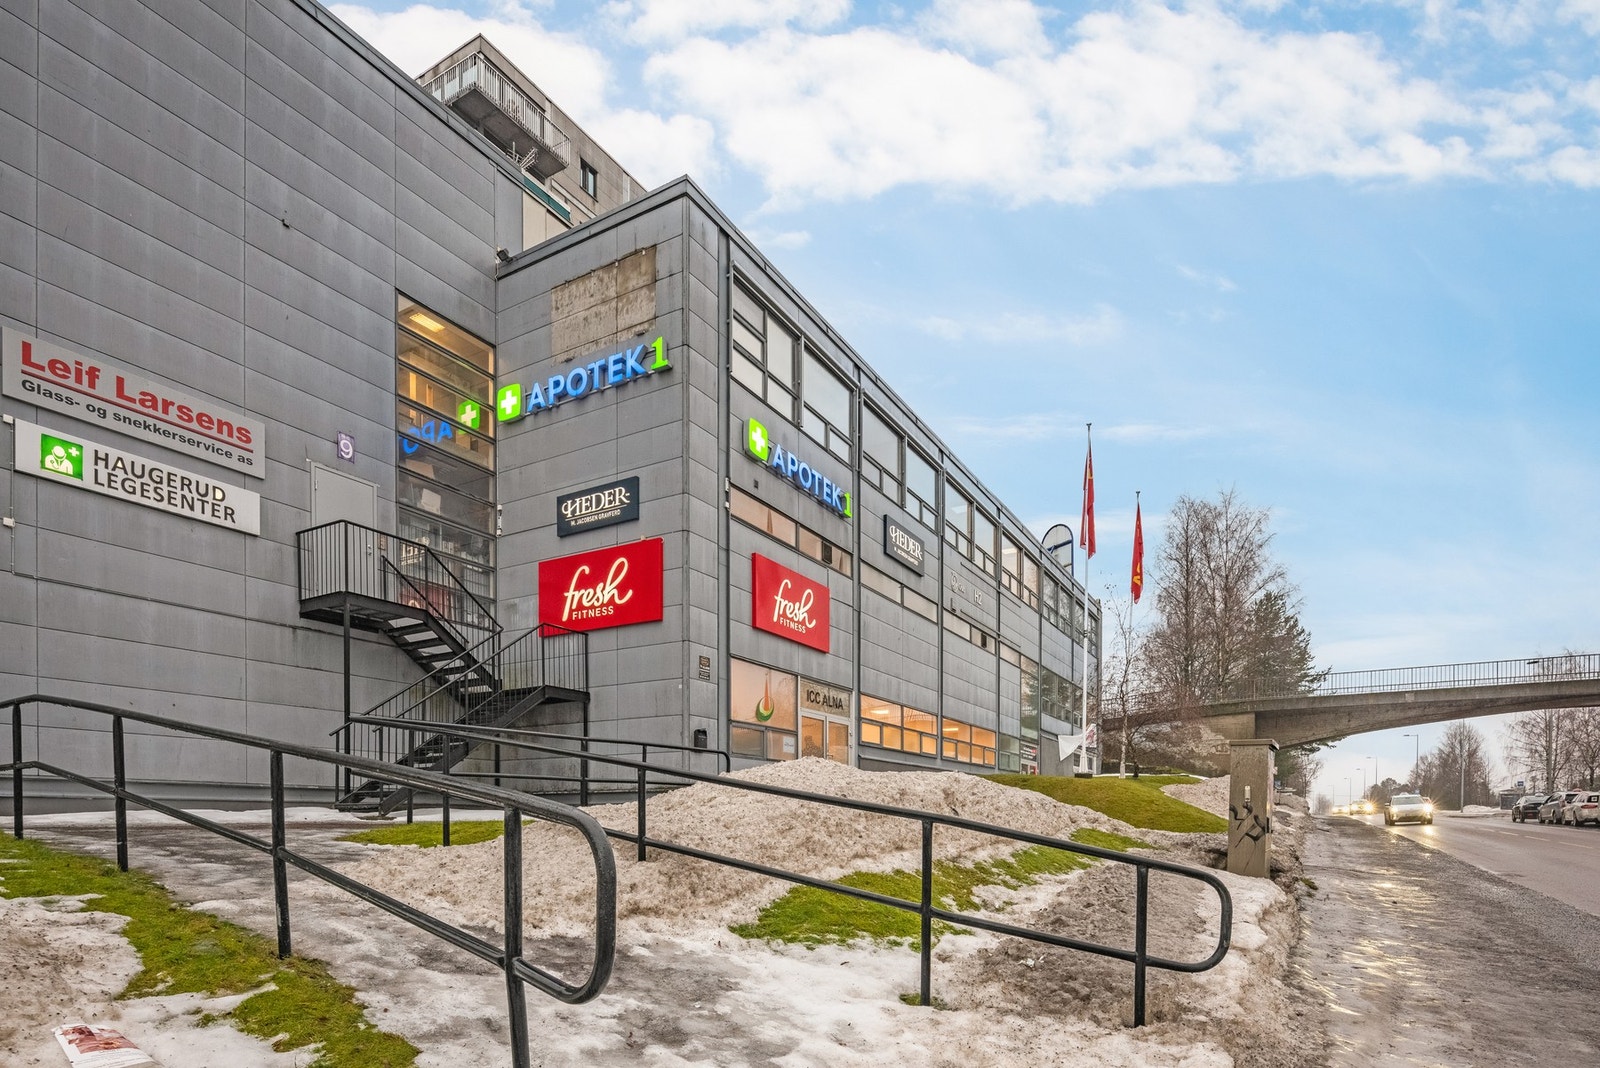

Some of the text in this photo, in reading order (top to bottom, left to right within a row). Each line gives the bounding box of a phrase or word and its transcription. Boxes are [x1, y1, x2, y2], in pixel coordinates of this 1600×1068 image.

[21, 340, 254, 445] Leif Larsens
[526, 336, 670, 413] APOTEK 1
[21, 379, 254, 466] Glass- og snekkerservice as
[340, 439, 353, 459] 9
[93, 449, 226, 502] HAUGERUD
[93, 468, 236, 524] LEGESENTER
[771, 444, 853, 518] APOTEK 1
[561, 557, 633, 622] fresh
[572, 605, 614, 621] FITNESS
[773, 578, 816, 630] fresh
[779, 617, 806, 634] FITNESS
[806, 689, 844, 711] ICC ALNA
